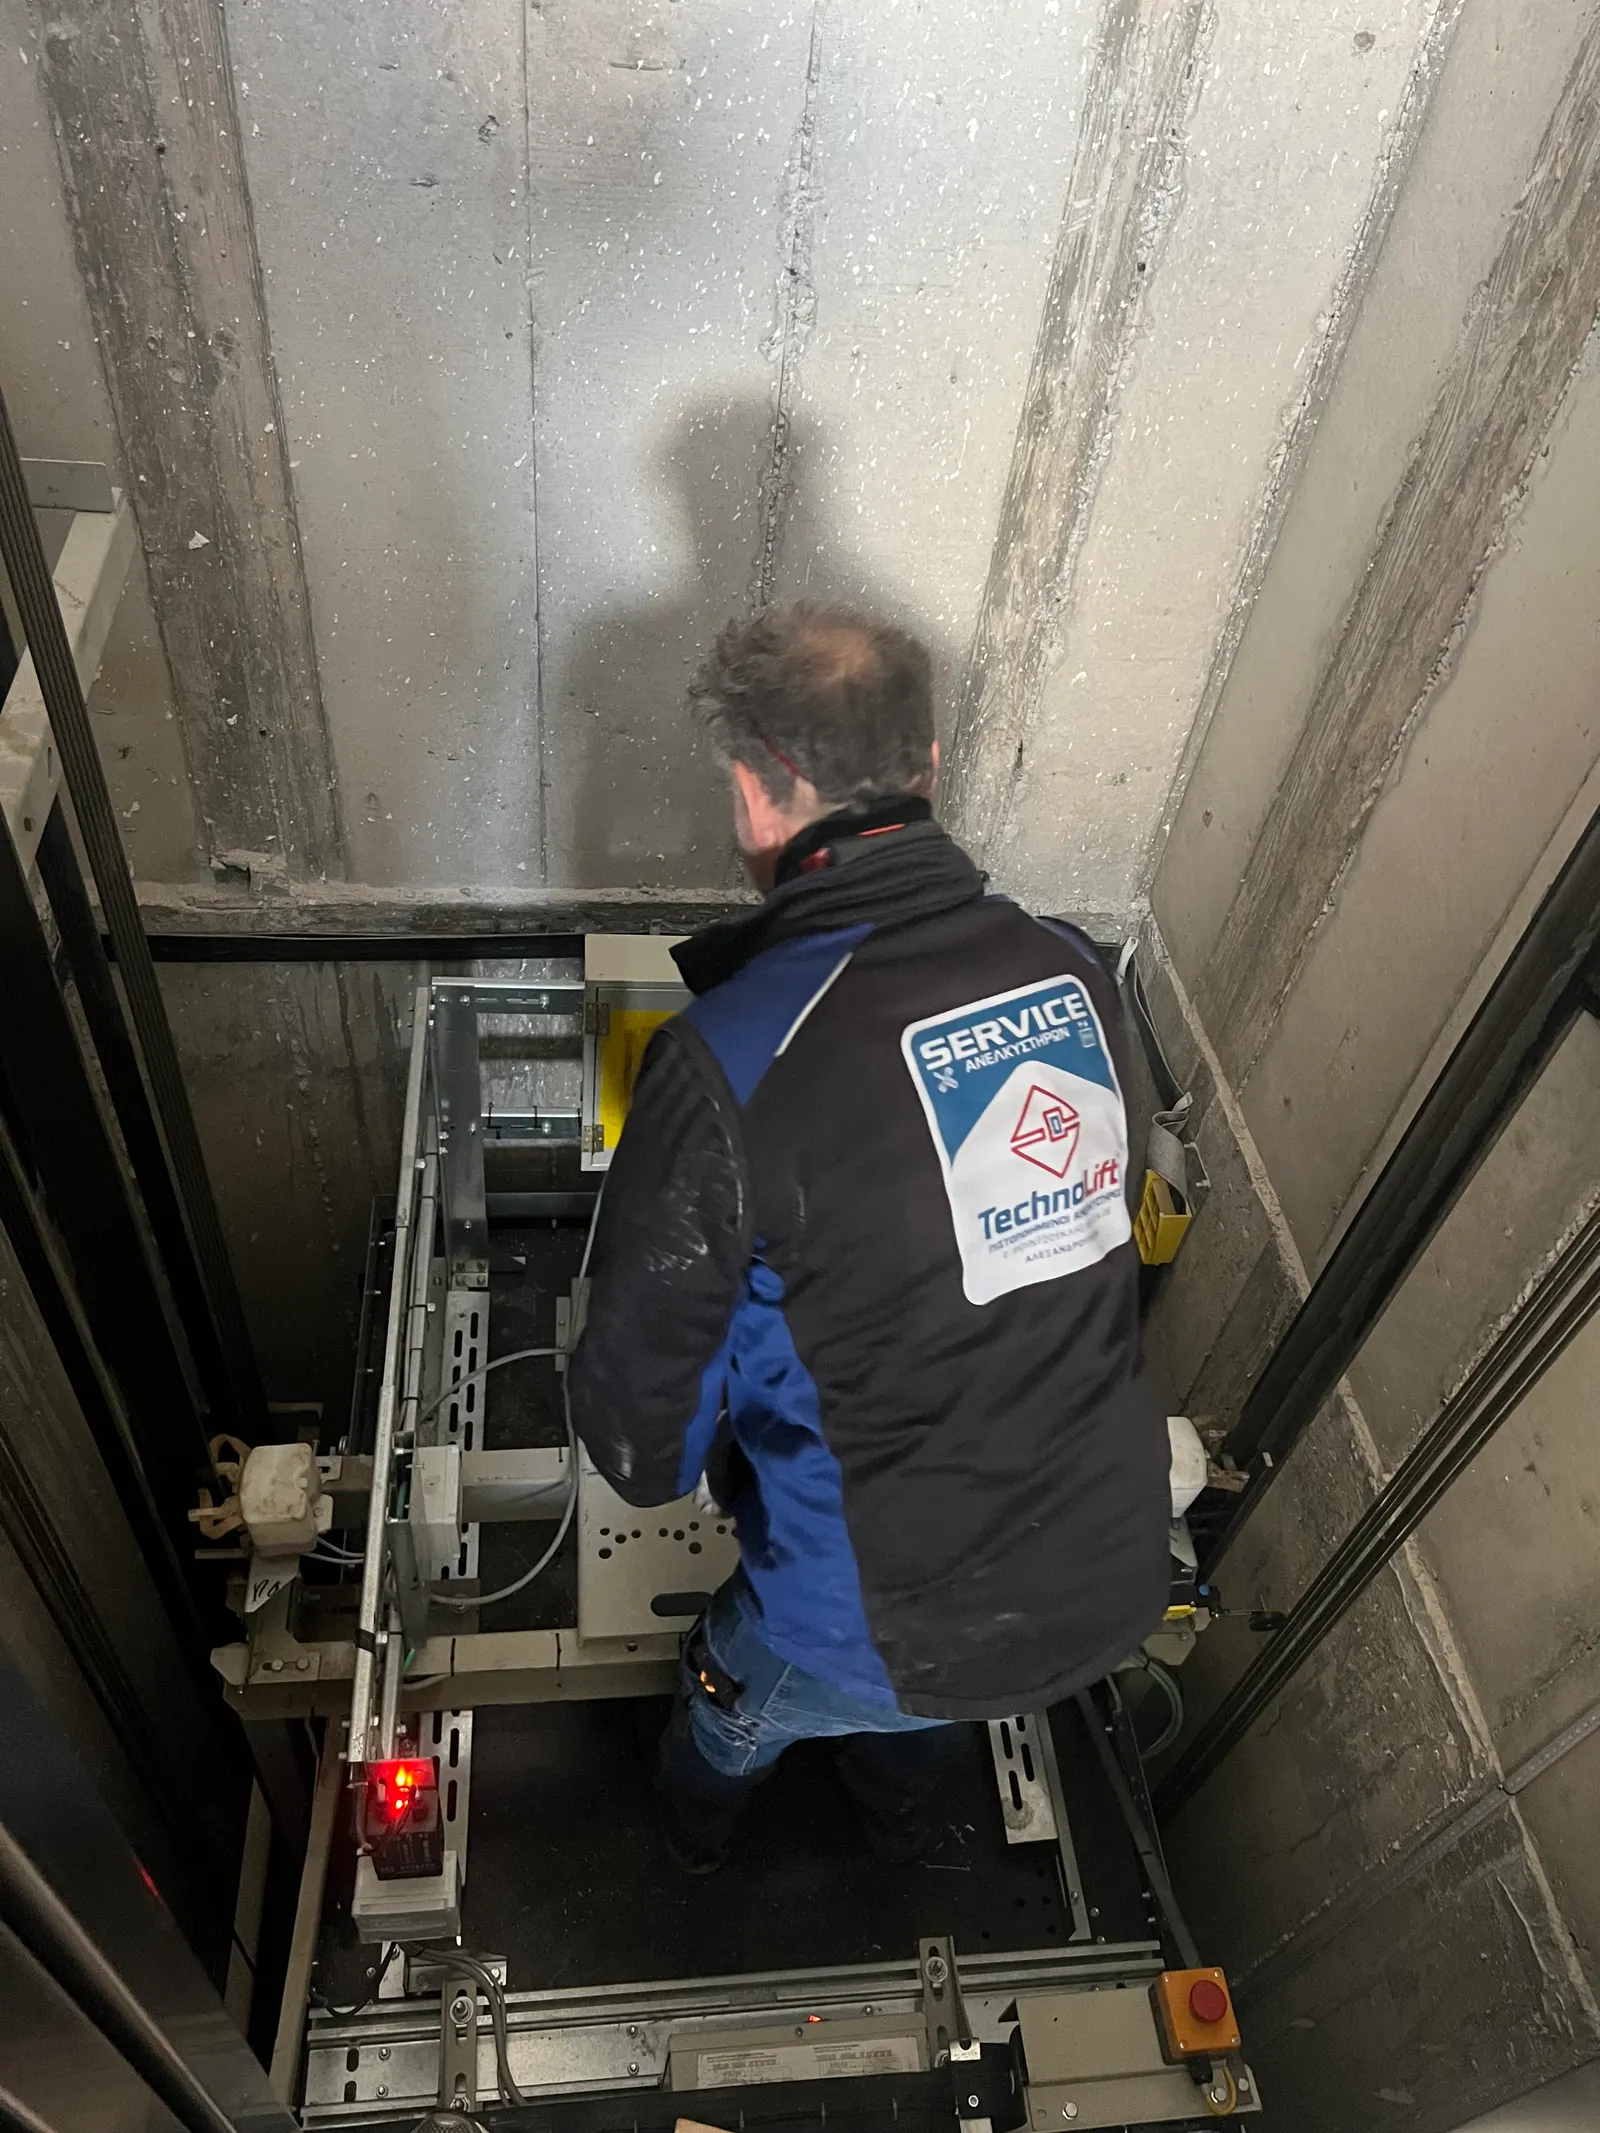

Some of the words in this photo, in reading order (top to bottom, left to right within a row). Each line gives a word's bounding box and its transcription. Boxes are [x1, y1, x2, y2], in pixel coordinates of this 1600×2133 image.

[920, 992, 1087, 1070] SERVICE
[965, 1026, 1070, 1073] ΑΝΕΛΚΥΣΤΗΡΩΝ
[978, 1158, 1119, 1240] TechnoLift
